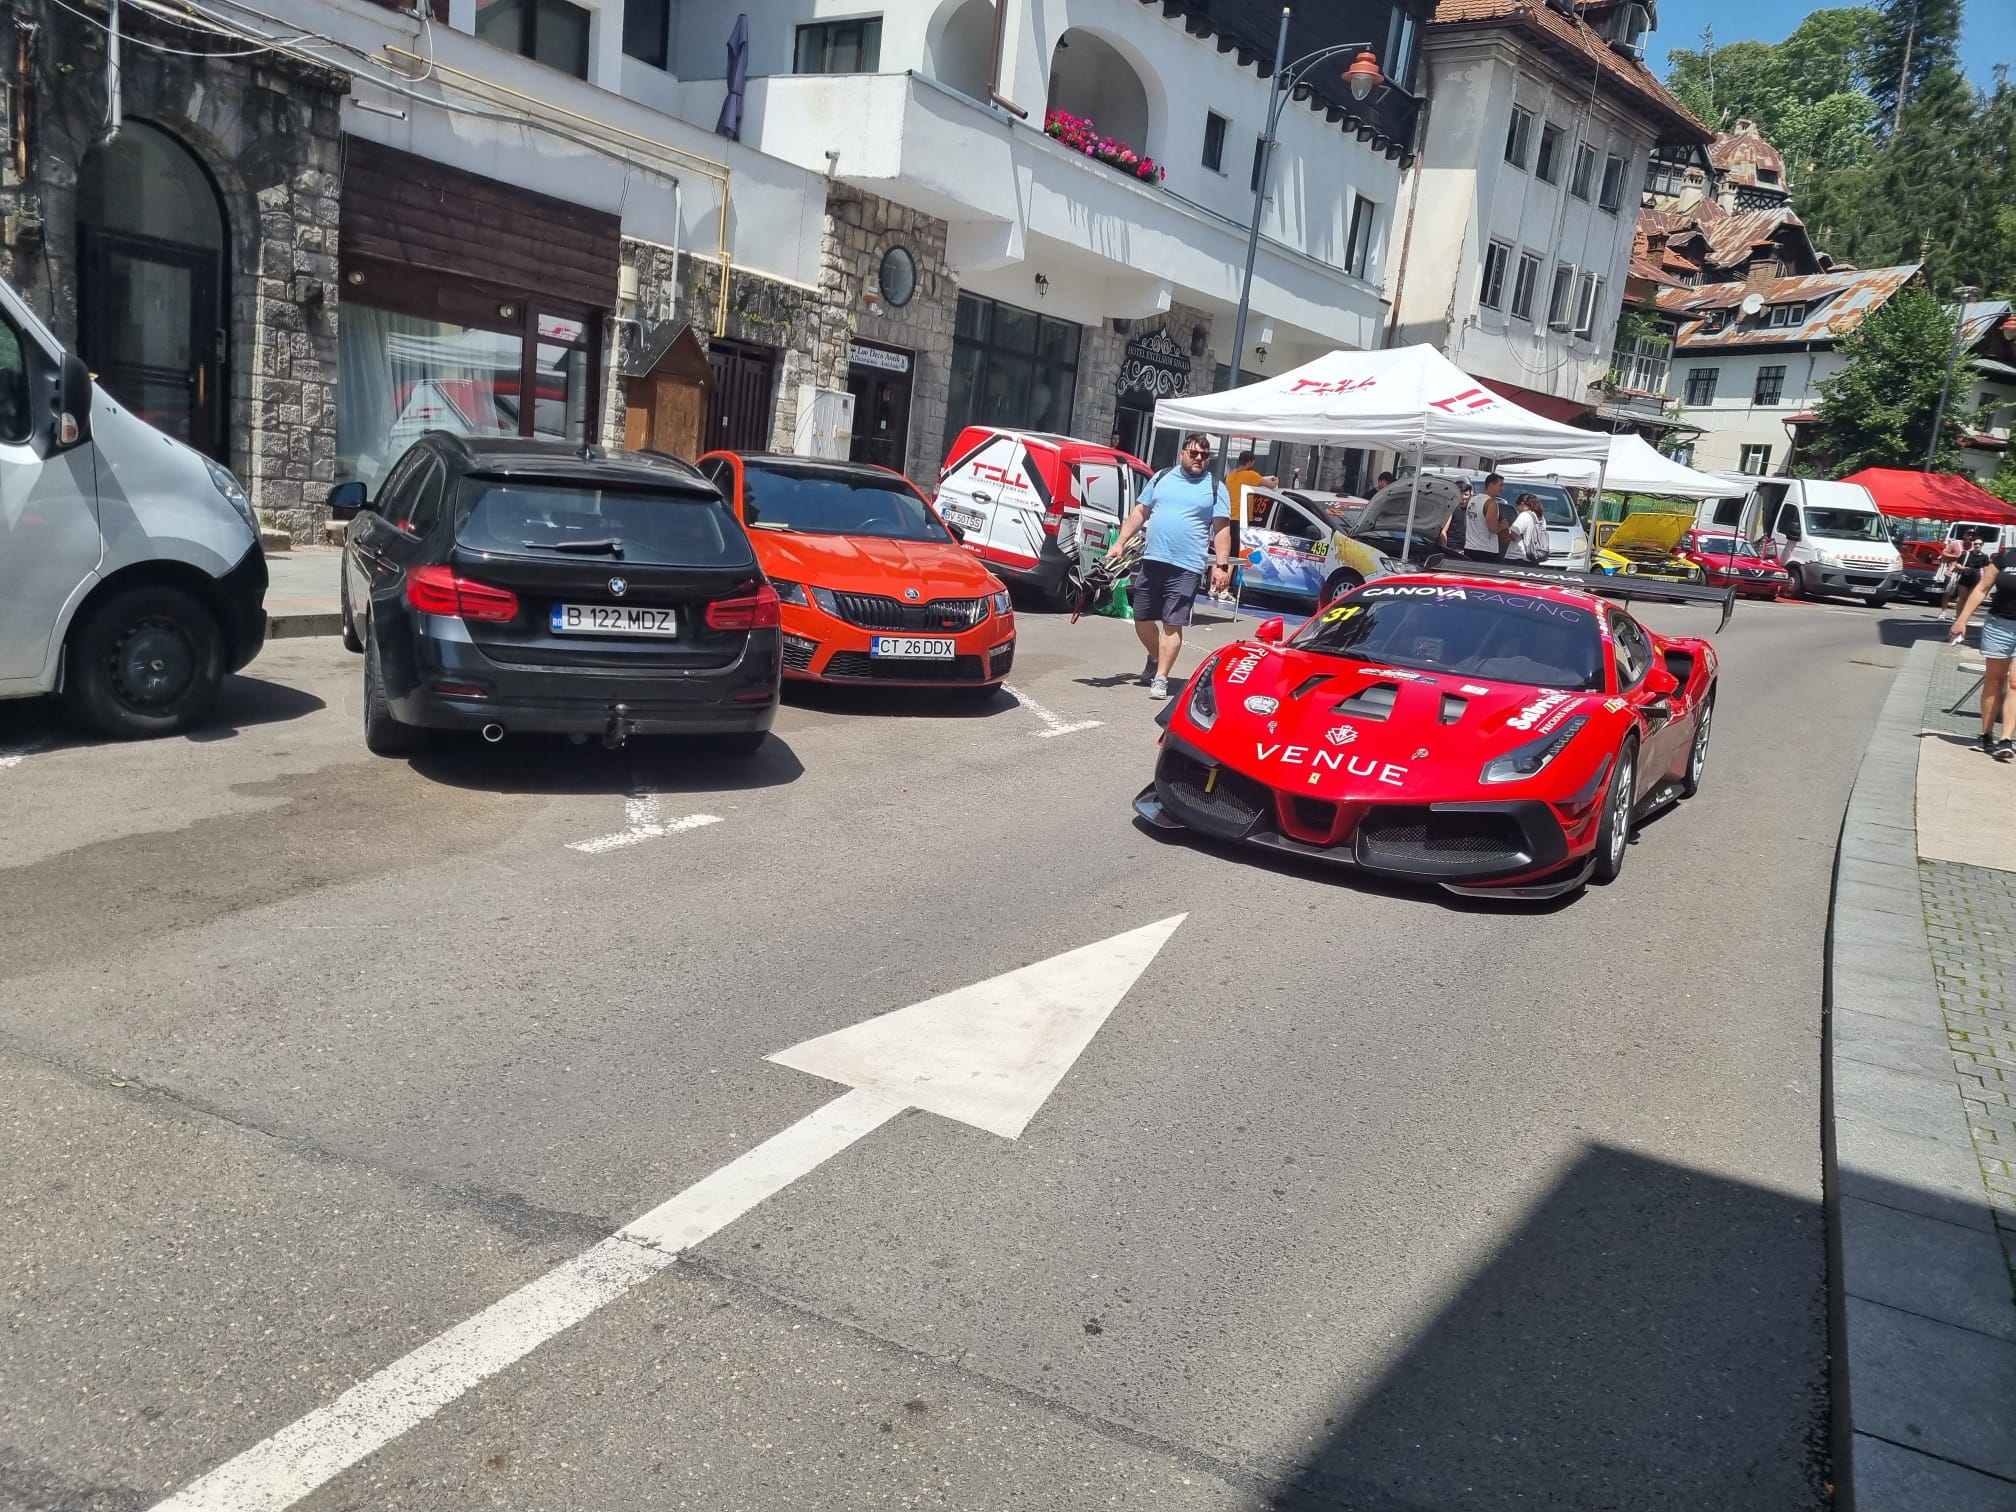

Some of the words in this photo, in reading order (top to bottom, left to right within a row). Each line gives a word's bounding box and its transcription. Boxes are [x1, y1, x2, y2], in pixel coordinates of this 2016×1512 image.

[1128, 345, 1146, 359] HOTEL
[1146, 352, 1173, 367] EXCELSIOR
[972, 462, 1028, 490] TELL
[945, 510, 955, 520] BV
[1311, 542, 1328, 556] 435
[1499, 569, 1584, 583] CANOVA
[1362, 586, 1467, 601] CANOVA
[1469, 591, 1582, 623] RACING
[567, 607, 582, 627] B
[1322, 606, 1361, 623] 31
[880, 639, 900, 654] CT
[1256, 742, 1408, 786] VENUE
